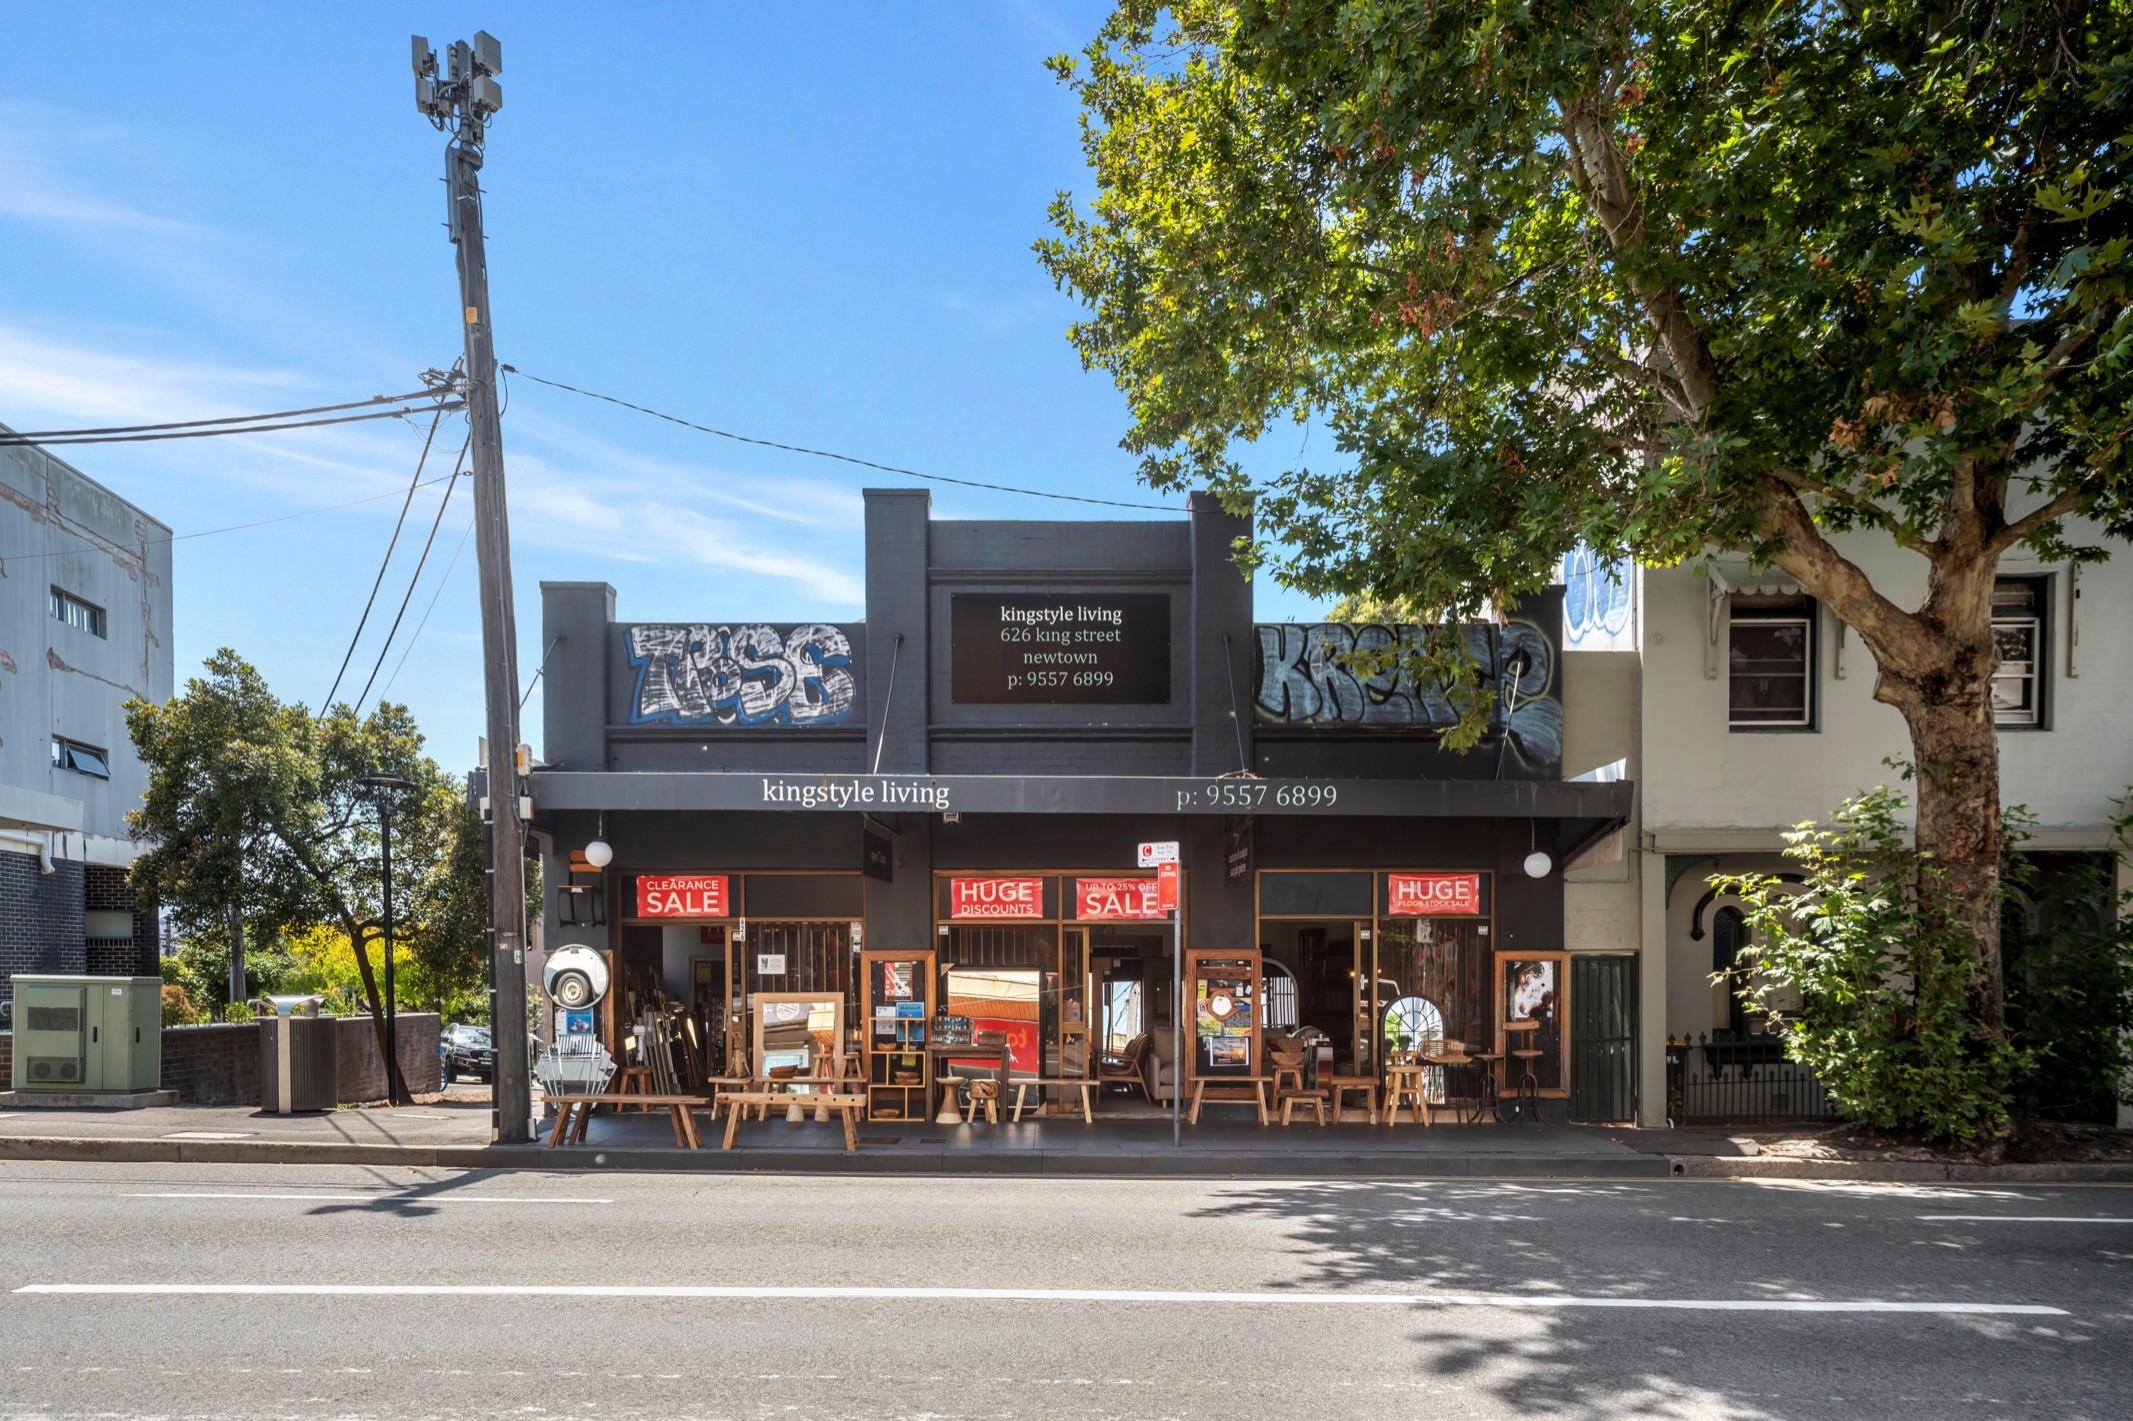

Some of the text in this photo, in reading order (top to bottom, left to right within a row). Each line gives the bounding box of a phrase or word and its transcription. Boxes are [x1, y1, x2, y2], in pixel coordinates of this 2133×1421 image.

[1001, 606, 1122, 625] kingstyle living
[1000, 627, 1122, 646] 626 king street
[1023, 651, 1099, 664] newtown
[1008, 671, 1114, 690] p: 9557 6899
[762, 779, 951, 810] kingstyle living
[1176, 785, 1337, 811] p: 9557 6899
[646, 880, 719, 890] CLEARANCE
[961, 882, 1034, 901] HUGE
[1398, 881, 1470, 900] HUGE
[646, 892, 720, 913] SALE
[961, 904, 1034, 914] DISCOUNTS
[1085, 893, 1158, 914] SALE
